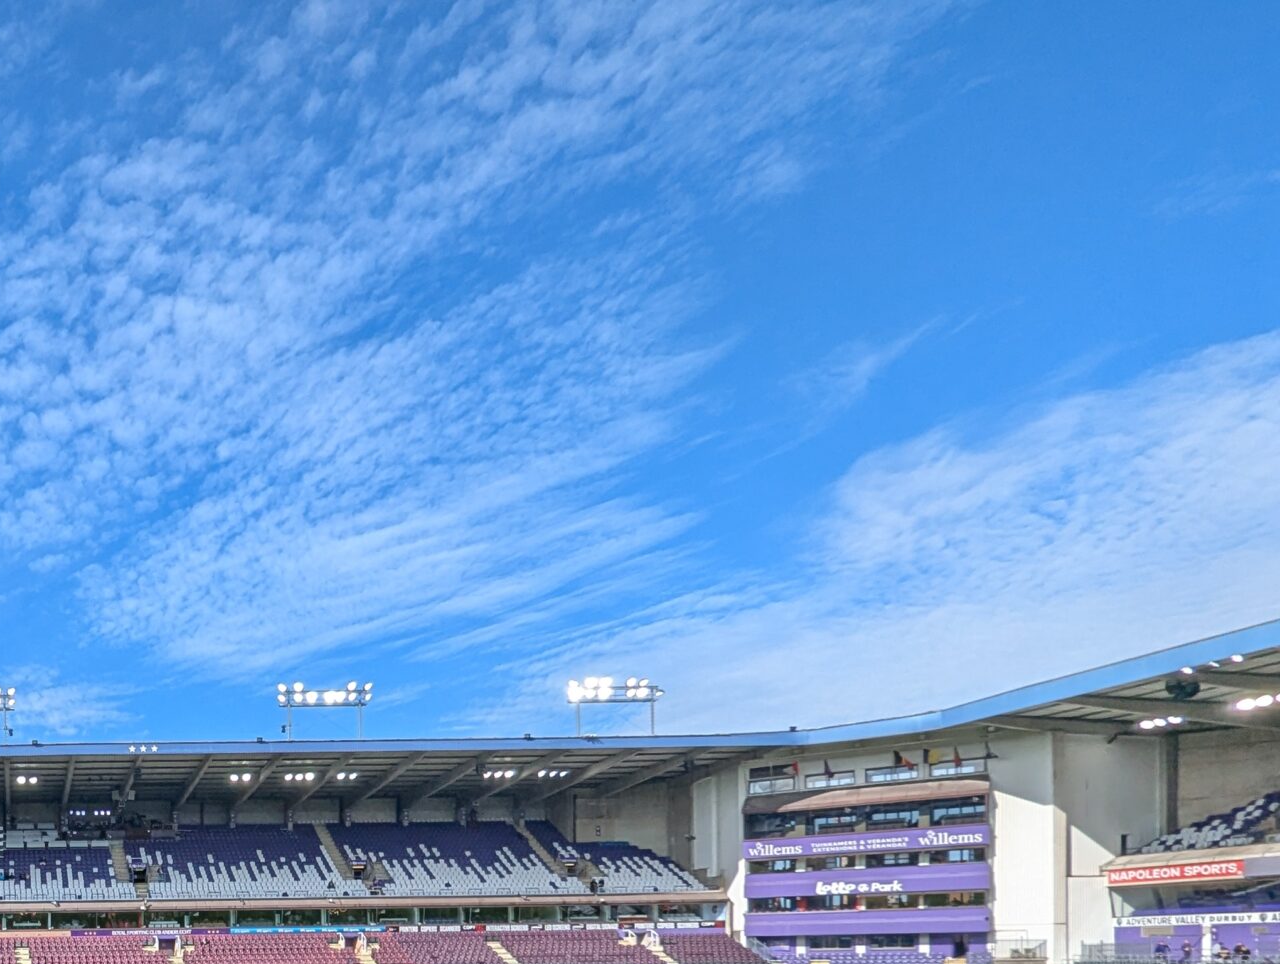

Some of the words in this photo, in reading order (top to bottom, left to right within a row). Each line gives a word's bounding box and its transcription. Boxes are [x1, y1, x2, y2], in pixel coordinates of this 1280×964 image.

[918, 831, 983, 846] willems
[749, 843, 802, 857] willems
[1110, 867, 1181, 881] NAPOLEON
[1184, 863, 1237, 876] SPORTS
[871, 880, 903, 892] Park
[1126, 916, 1174, 925] ADVENTURE
[1175, 915, 1206, 924] VALLEY
[1209, 914, 1253, 922] DURBUY
